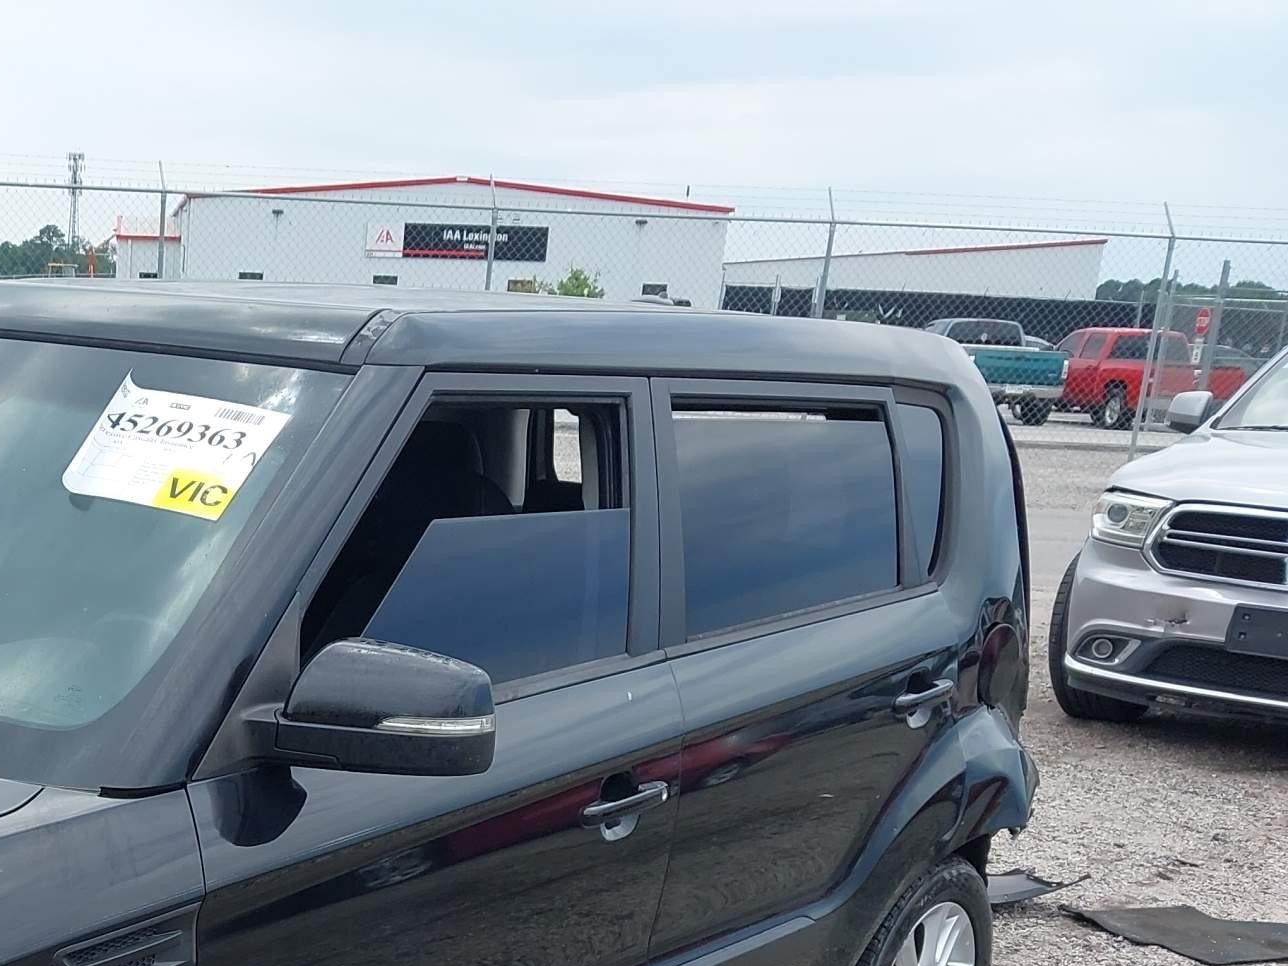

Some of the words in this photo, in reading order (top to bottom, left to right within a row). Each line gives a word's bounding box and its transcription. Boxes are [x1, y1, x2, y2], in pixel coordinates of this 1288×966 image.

[443, 229, 461, 241] IAA
[463, 229, 508, 243] Lexinon
[107, 411, 248, 449] 45269363
[169, 476, 228, 507] VIC
